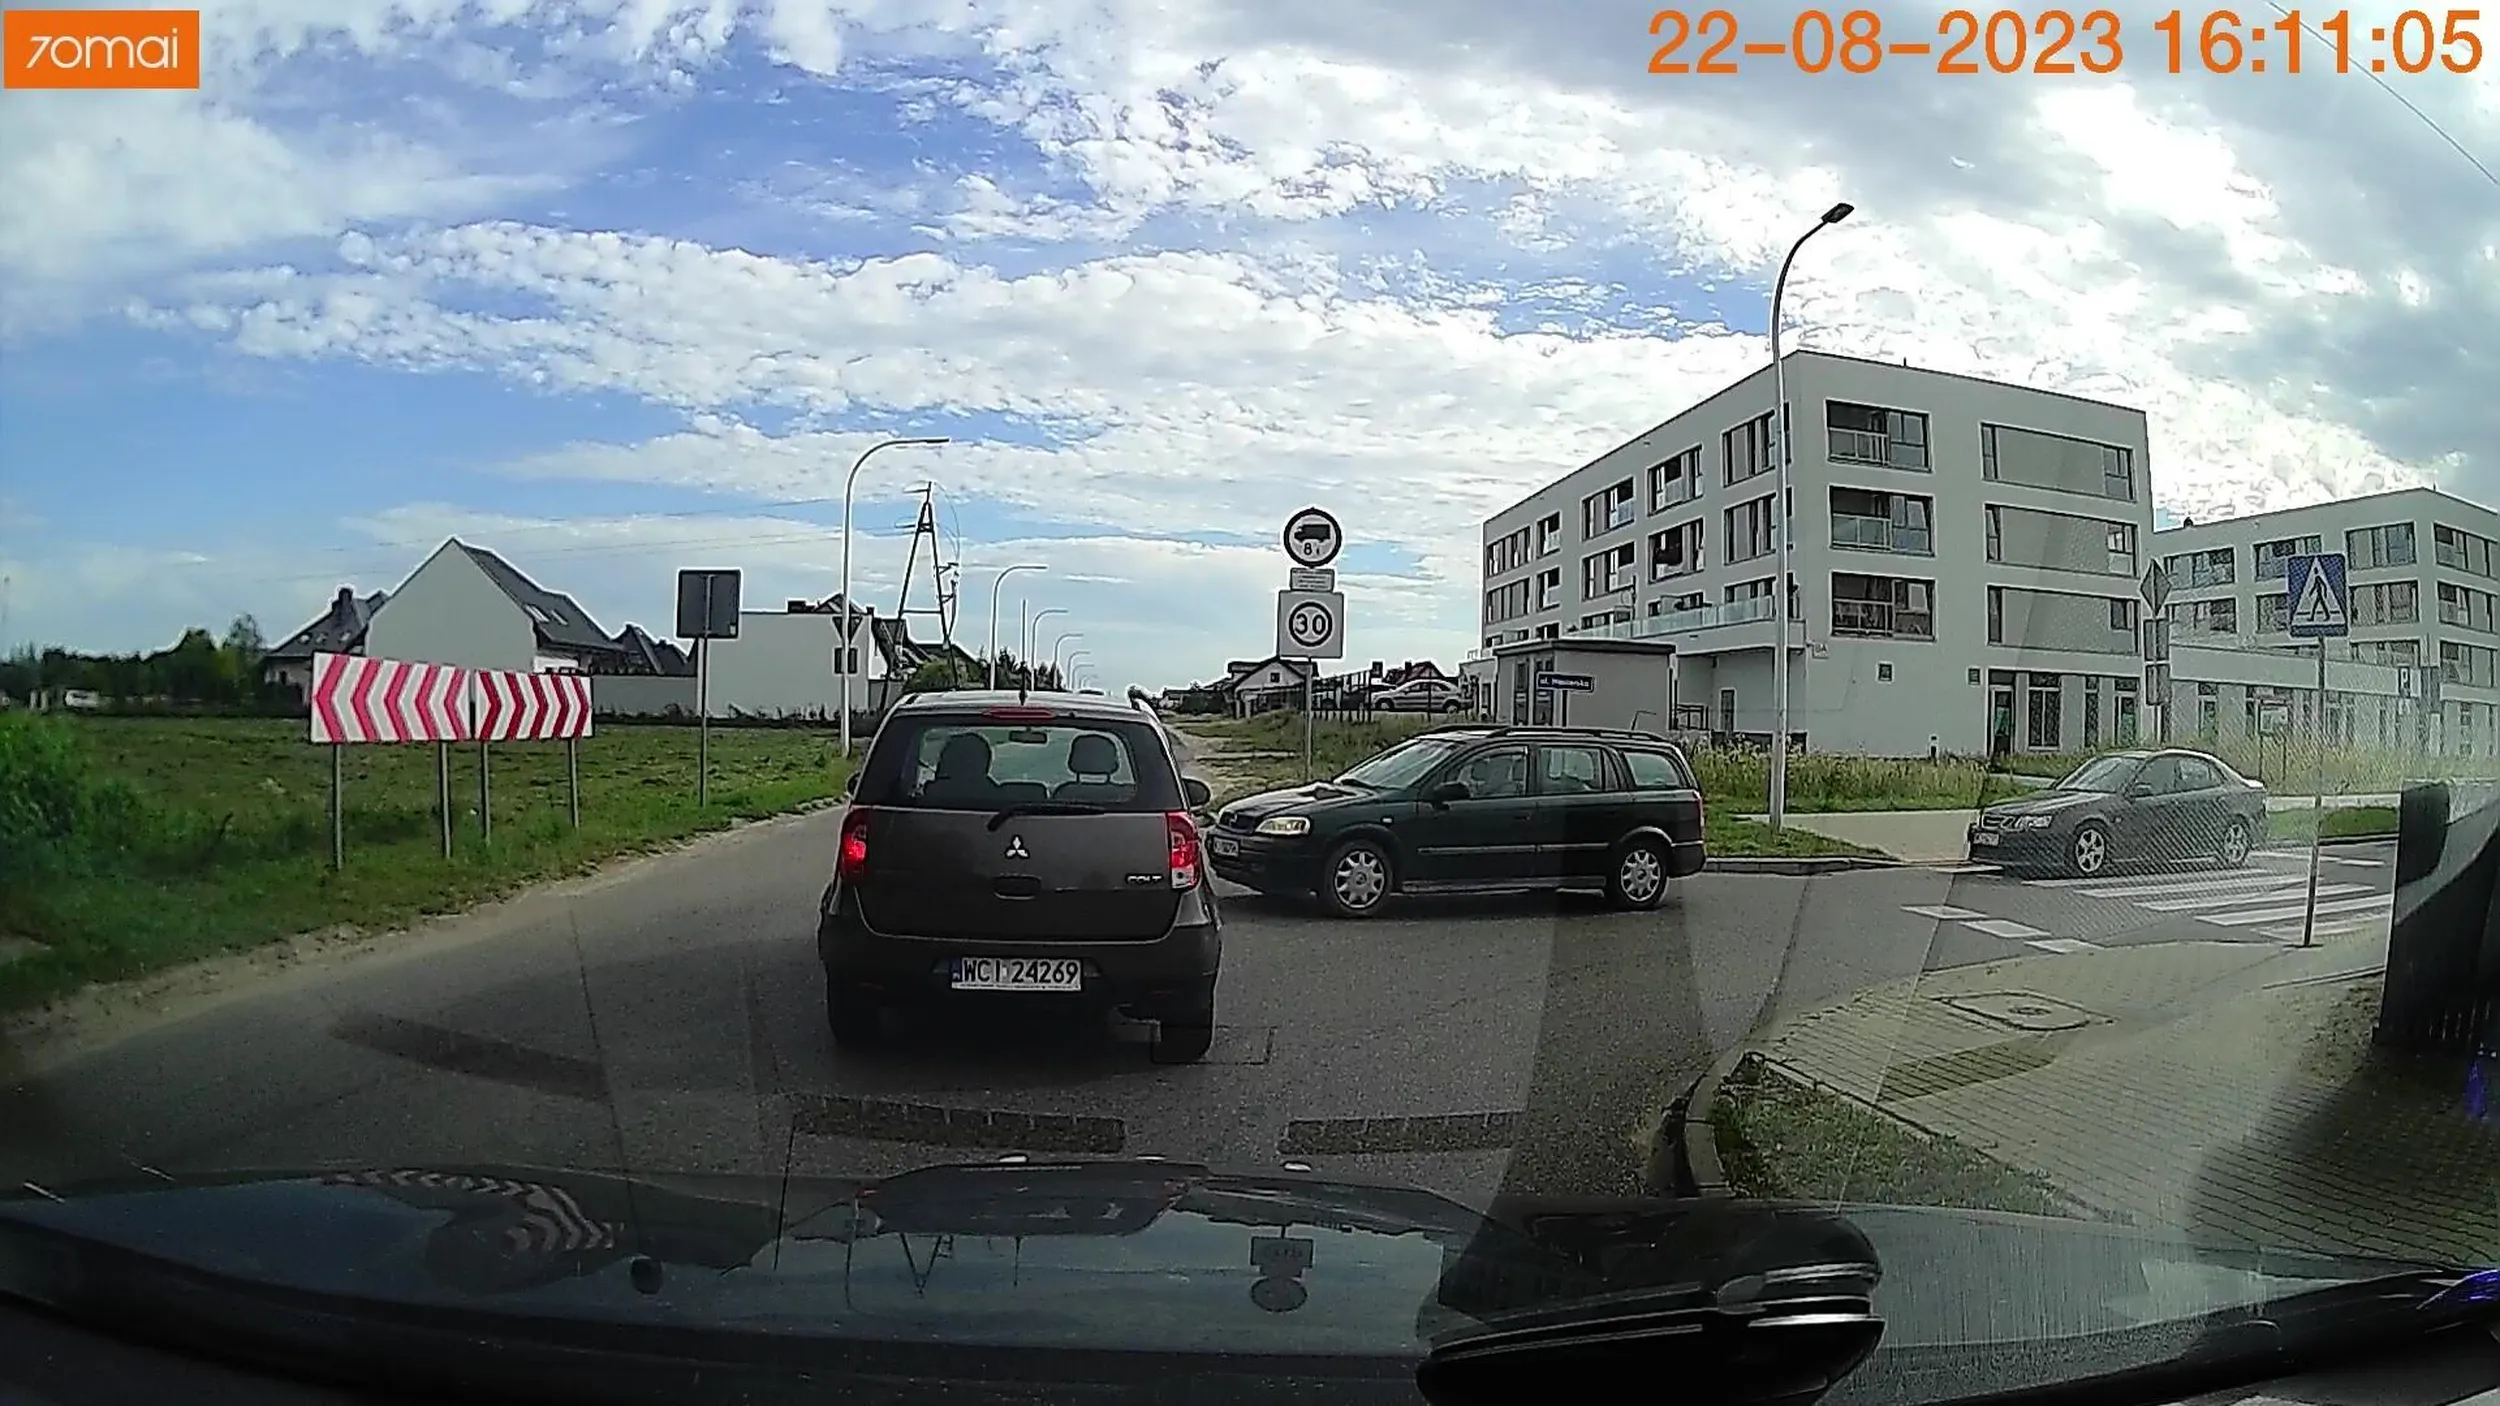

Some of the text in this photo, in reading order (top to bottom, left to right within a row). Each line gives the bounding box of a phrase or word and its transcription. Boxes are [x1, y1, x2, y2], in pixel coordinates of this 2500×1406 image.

[1294, 613, 1327, 635] 30
[964, 960, 1079, 984] WCI 24269
